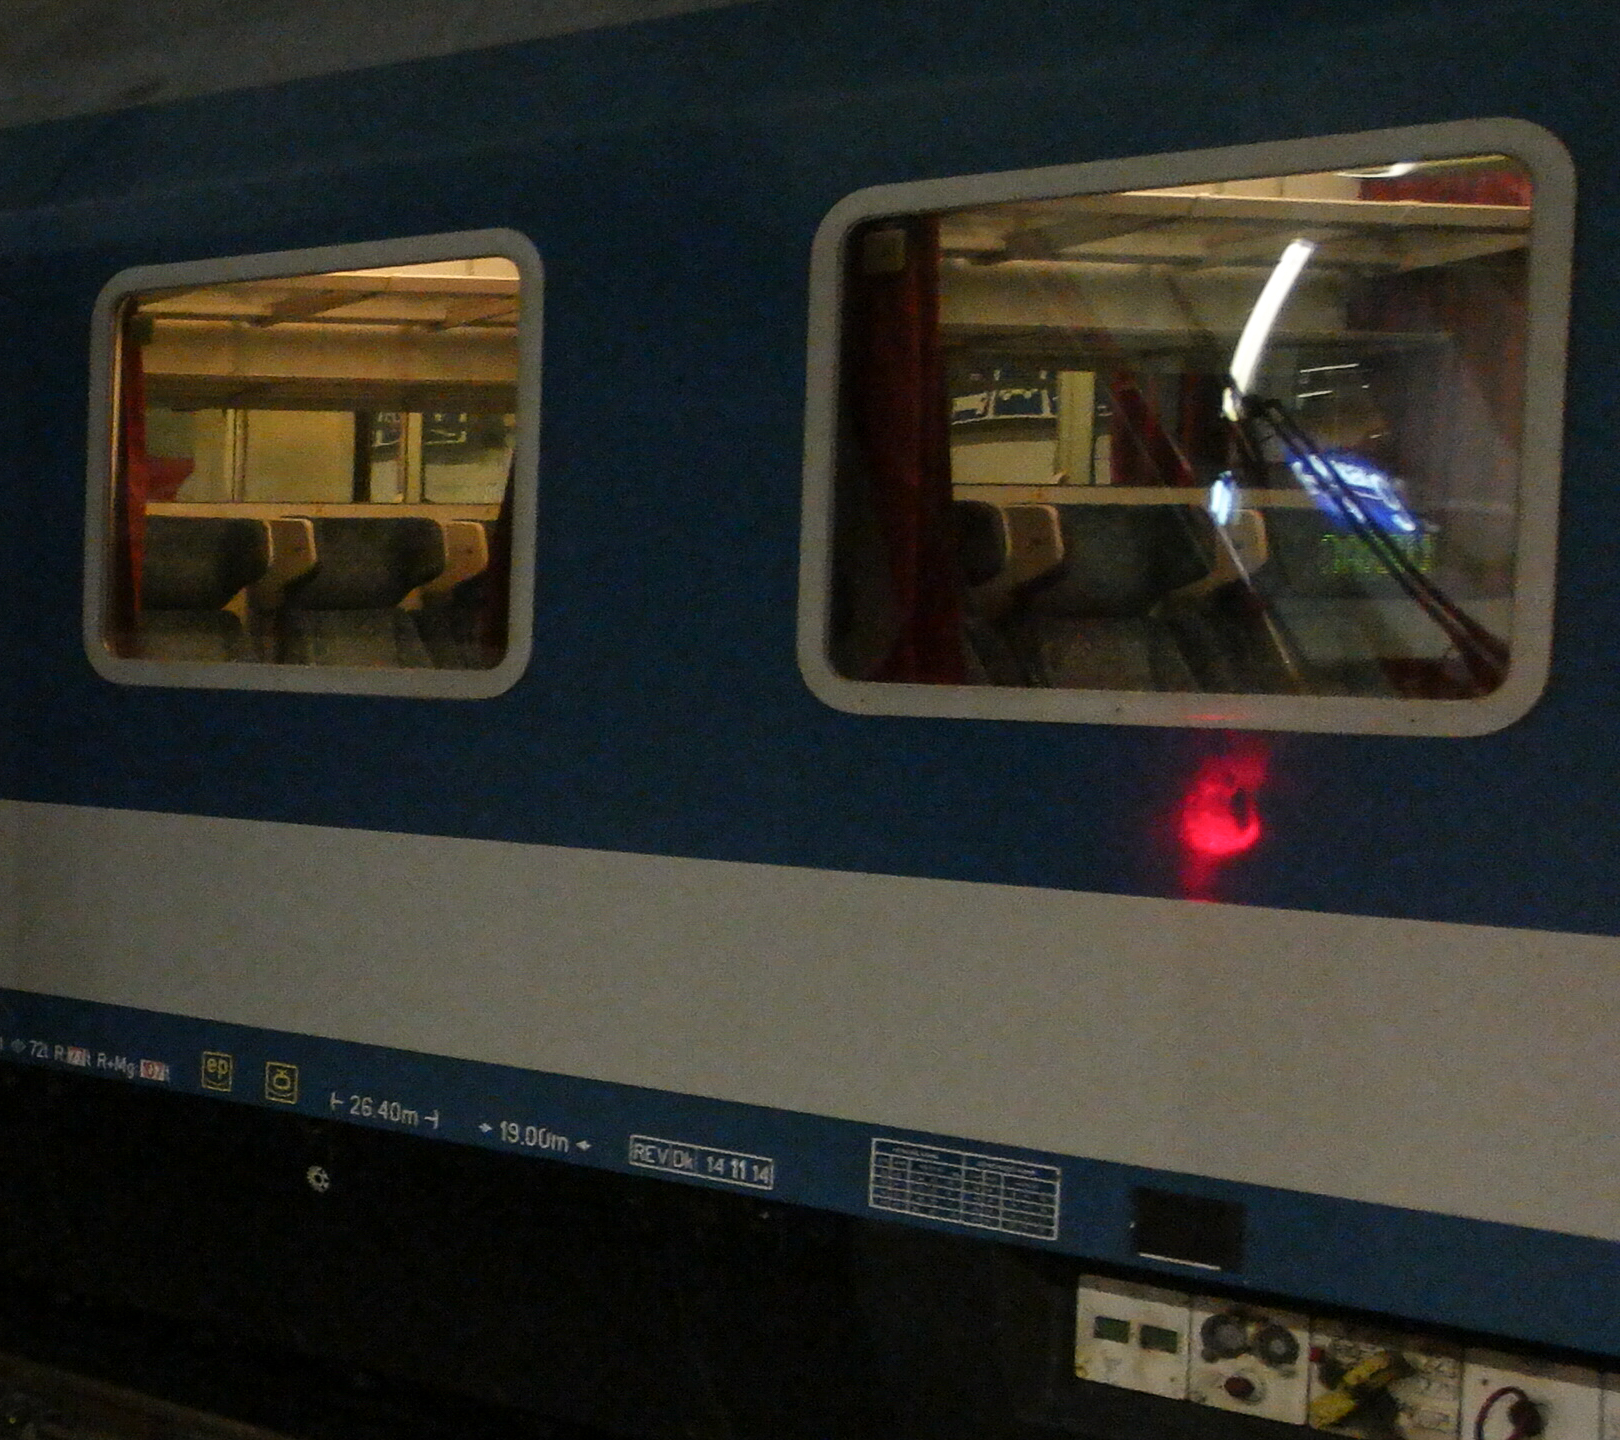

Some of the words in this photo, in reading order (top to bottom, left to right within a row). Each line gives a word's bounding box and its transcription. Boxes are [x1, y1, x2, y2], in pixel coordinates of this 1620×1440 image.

[206, 1058, 229, 1079] ep
[349, 1094, 419, 1127] 26.40m
[499, 1119, 569, 1153] 19.00m
[632, 1142, 670, 1165] REV
[706, 1155, 726, 1176] 14
